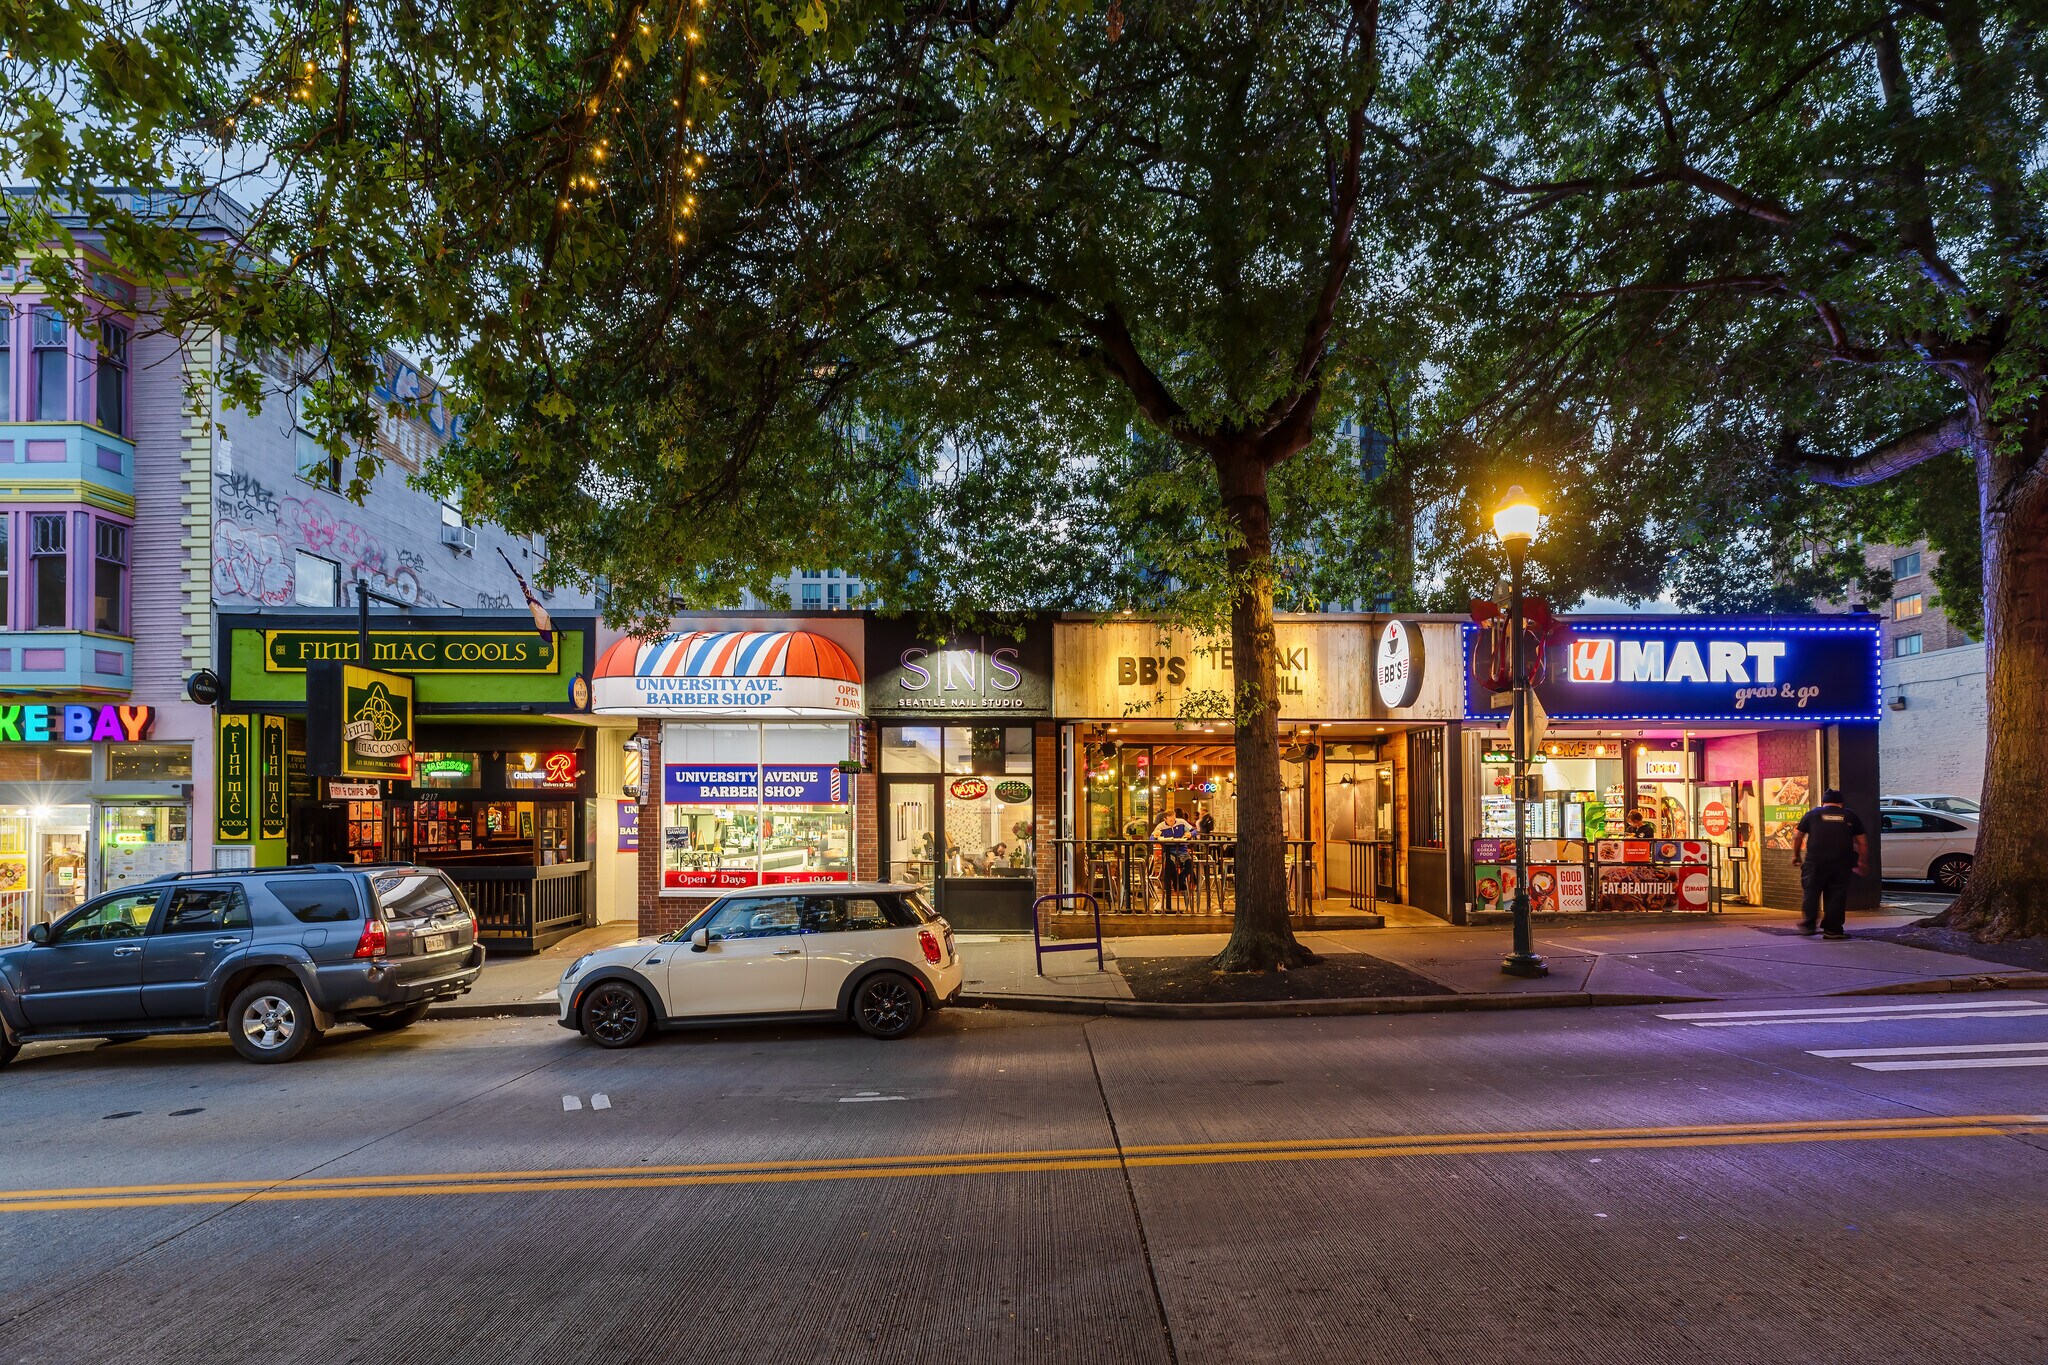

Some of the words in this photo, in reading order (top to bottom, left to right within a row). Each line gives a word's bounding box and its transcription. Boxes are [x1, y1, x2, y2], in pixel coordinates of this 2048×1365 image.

[298, 642, 359, 660] FINN
[372, 642, 436, 661] MAC
[444, 642, 527, 662] COOLS
[1208, 647, 1309, 671] TEAKI
[1575, 641, 1611, 681] H
[1620, 641, 1786, 682] MART
[1118, 656, 1186, 686] BB'S
[1384, 661, 1402, 684] BB'S
[635, 679, 742, 691] UNIVERSITY
[745, 679, 783, 691] AVE.
[837, 685, 859, 697] OPEN
[646, 693, 719, 705] BARBER
[722, 693, 772, 705] SHOP
[1735, 683, 1777, 709] grab
[1781, 683, 1795, 698] &
[1798, 685, 1820, 708] go
[835, 697, 841, 706] 7
[842, 697, 861, 710] DAYS
[899, 699, 946, 707] SEATTLE
[951, 699, 977, 707] NAIL
[981, 699, 1023, 707] STUDIO
[1426, 709, 1453, 718] 4221
[64, 705, 148, 742] BAY
[348, 721, 372, 737] FINN
[229, 732, 242, 776] FINN
[269, 733, 279, 776] FINN
[358, 743, 379, 754] MAC
[380, 743, 407, 754] COOLS
[546, 754, 571, 781] R
[675, 771, 758, 783] UNIVERSITY
[764, 771, 818, 783] AVENUE
[331, 786, 341, 796] FISH
[348, 787, 364, 796] CHIPS
[700, 786, 758, 798] BARBER
[764, 786, 805, 798] SHOP
[953, 783, 986, 795] WAXING
[1198, 783, 1221, 794] open
[227, 781, 242, 814] MAC
[268, 782, 279, 814] MAC
[1776, 812, 1786, 820] EAT
[221, 819, 248, 827] COOLS
[678, 874, 707, 886] Open
[711, 874, 717, 883] 7
[721, 874, 746, 887] Days
[1560, 871, 1581, 882] GOOD
[1560, 884, 1583, 896] VIBES
[1602, 882, 1620, 894] EAT
[1621, 882, 1675, 895] BEAUTIFUL
